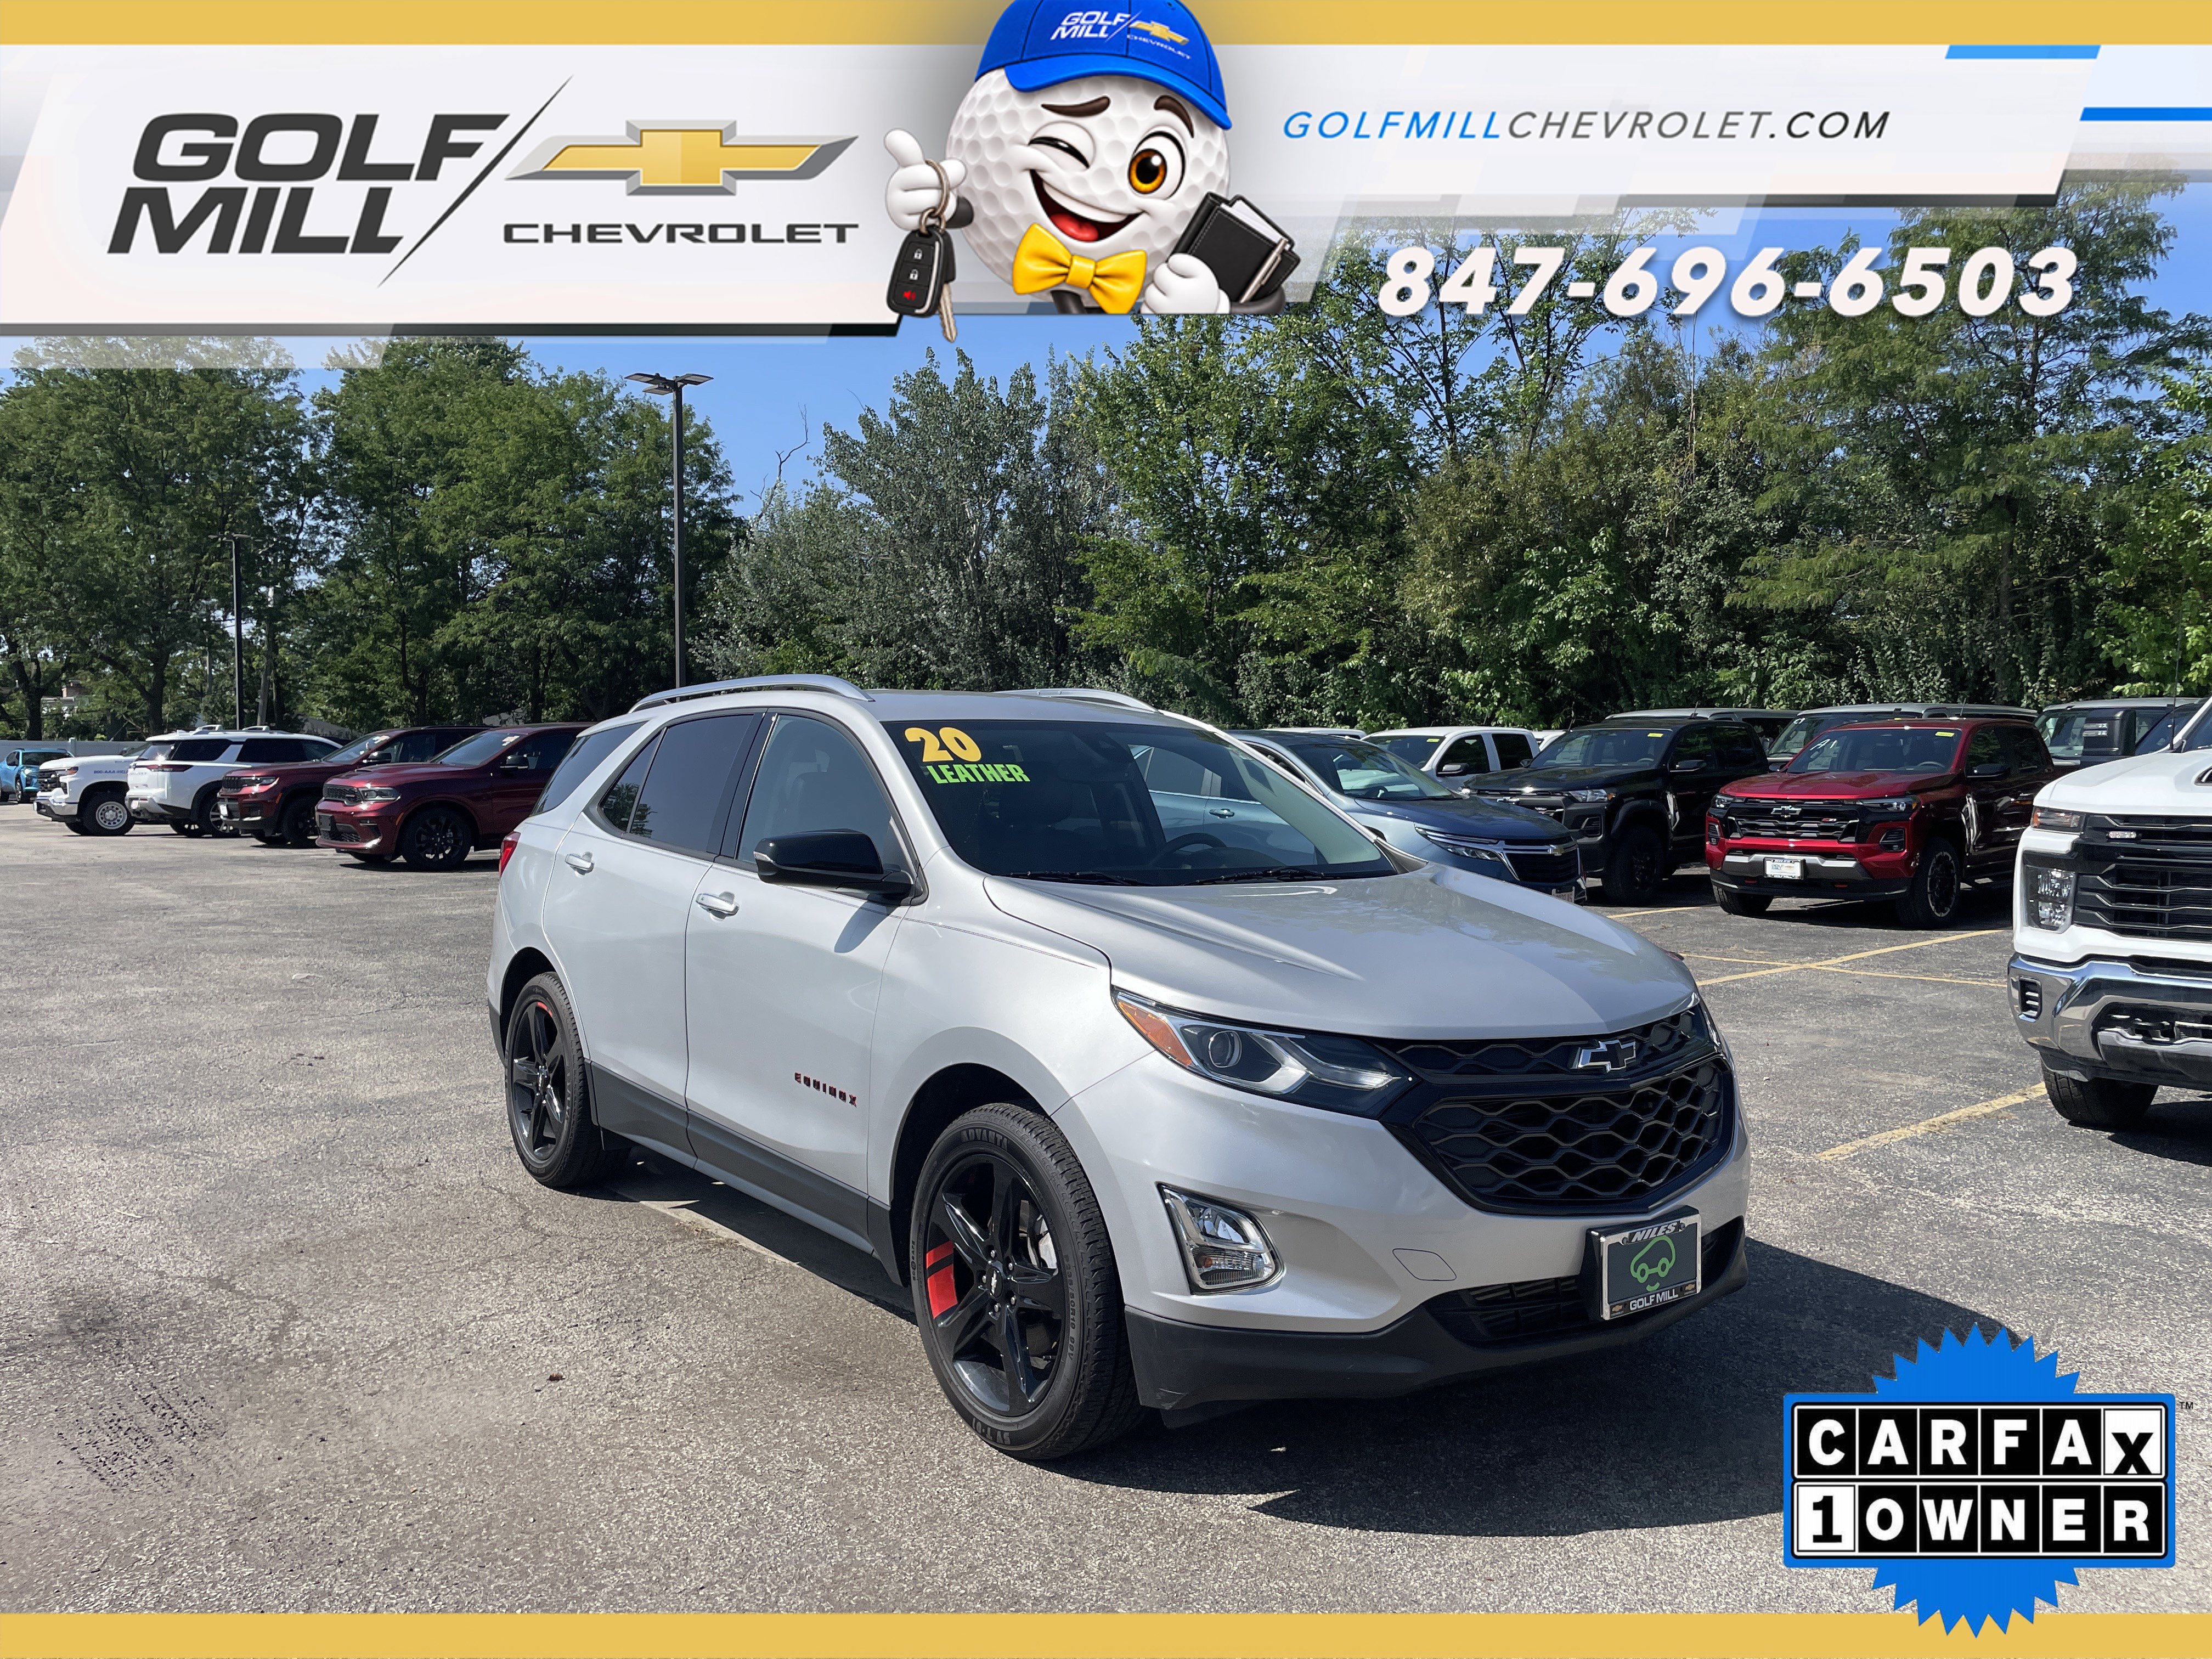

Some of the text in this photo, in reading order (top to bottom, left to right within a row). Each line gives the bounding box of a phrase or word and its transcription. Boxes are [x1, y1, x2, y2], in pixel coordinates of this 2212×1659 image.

[905, 727, 982, 763] 20
[927, 764, 1031, 785] LEATHER
[794, 1072, 857, 1108] EQUINOX
[961, 1128, 1008, 1152] ADVANTA
[1631, 1221, 1678, 1243] NILES
[1629, 1288, 1678, 1311] GOLF MILL
